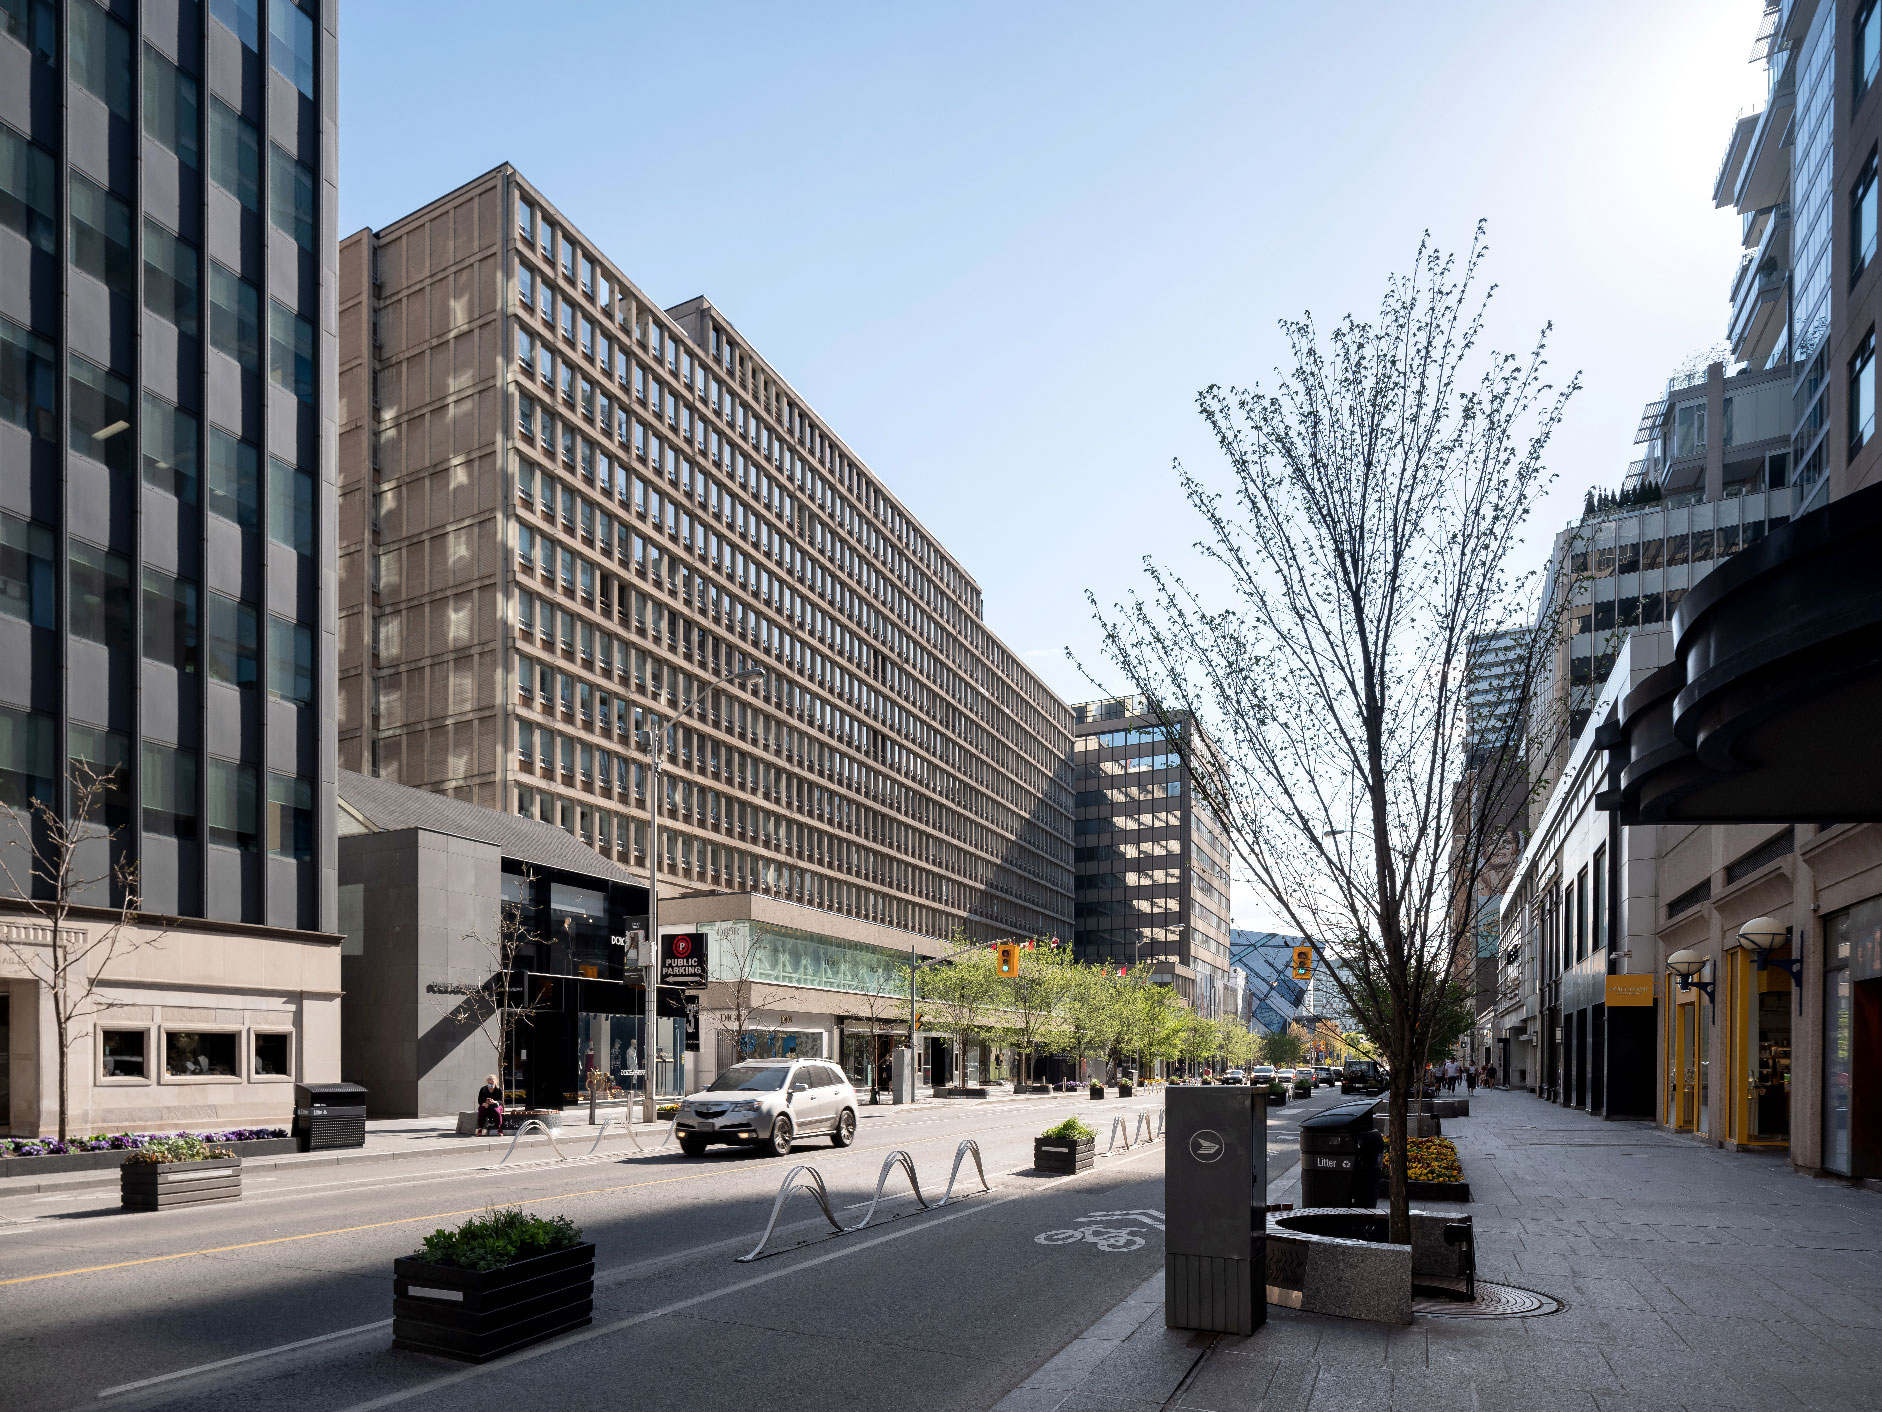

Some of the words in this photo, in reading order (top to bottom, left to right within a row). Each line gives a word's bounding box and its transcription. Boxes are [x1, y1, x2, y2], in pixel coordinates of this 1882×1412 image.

[679, 942, 686, 951] P
[665, 958, 698, 967] PUBLIC
[662, 967, 702, 975] PARKING
[1317, 1157, 1336, 1168] Litter
